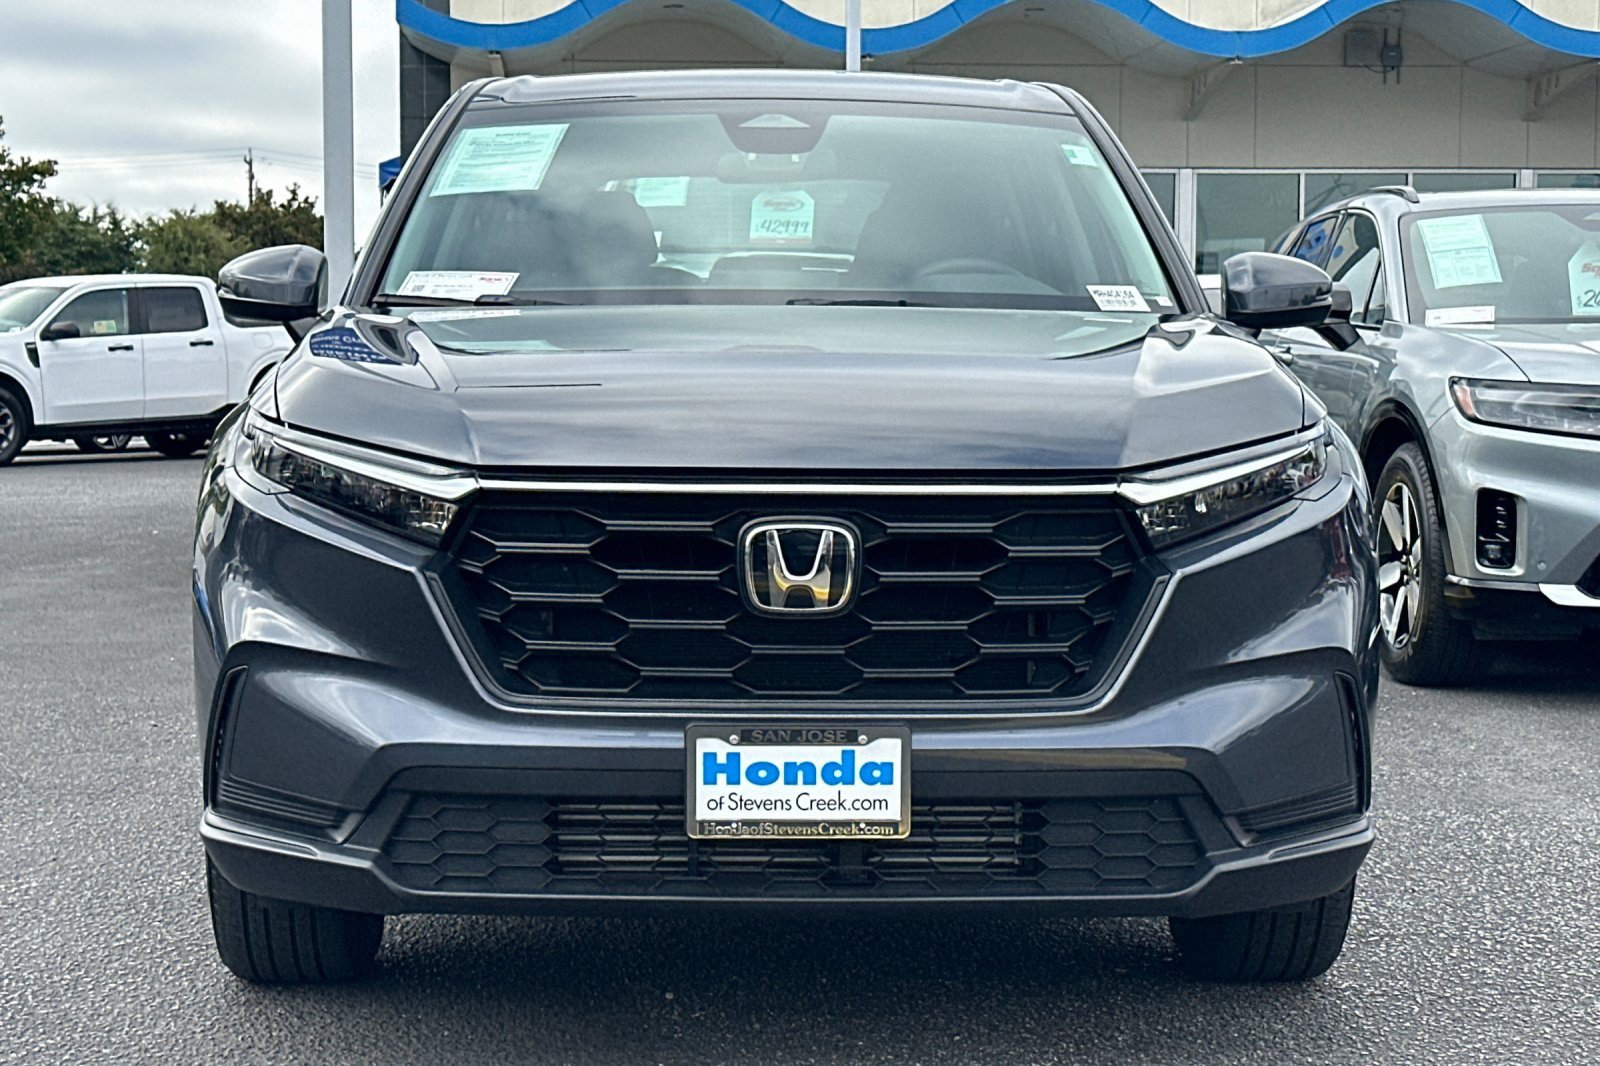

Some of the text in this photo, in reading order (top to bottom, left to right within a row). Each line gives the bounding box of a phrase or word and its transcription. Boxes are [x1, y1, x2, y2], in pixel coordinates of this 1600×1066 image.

[750, 729, 848, 743] SAN JOSE
[703, 749, 894, 786] Honda
[707, 790, 889, 811] of Stevens Creek.com
